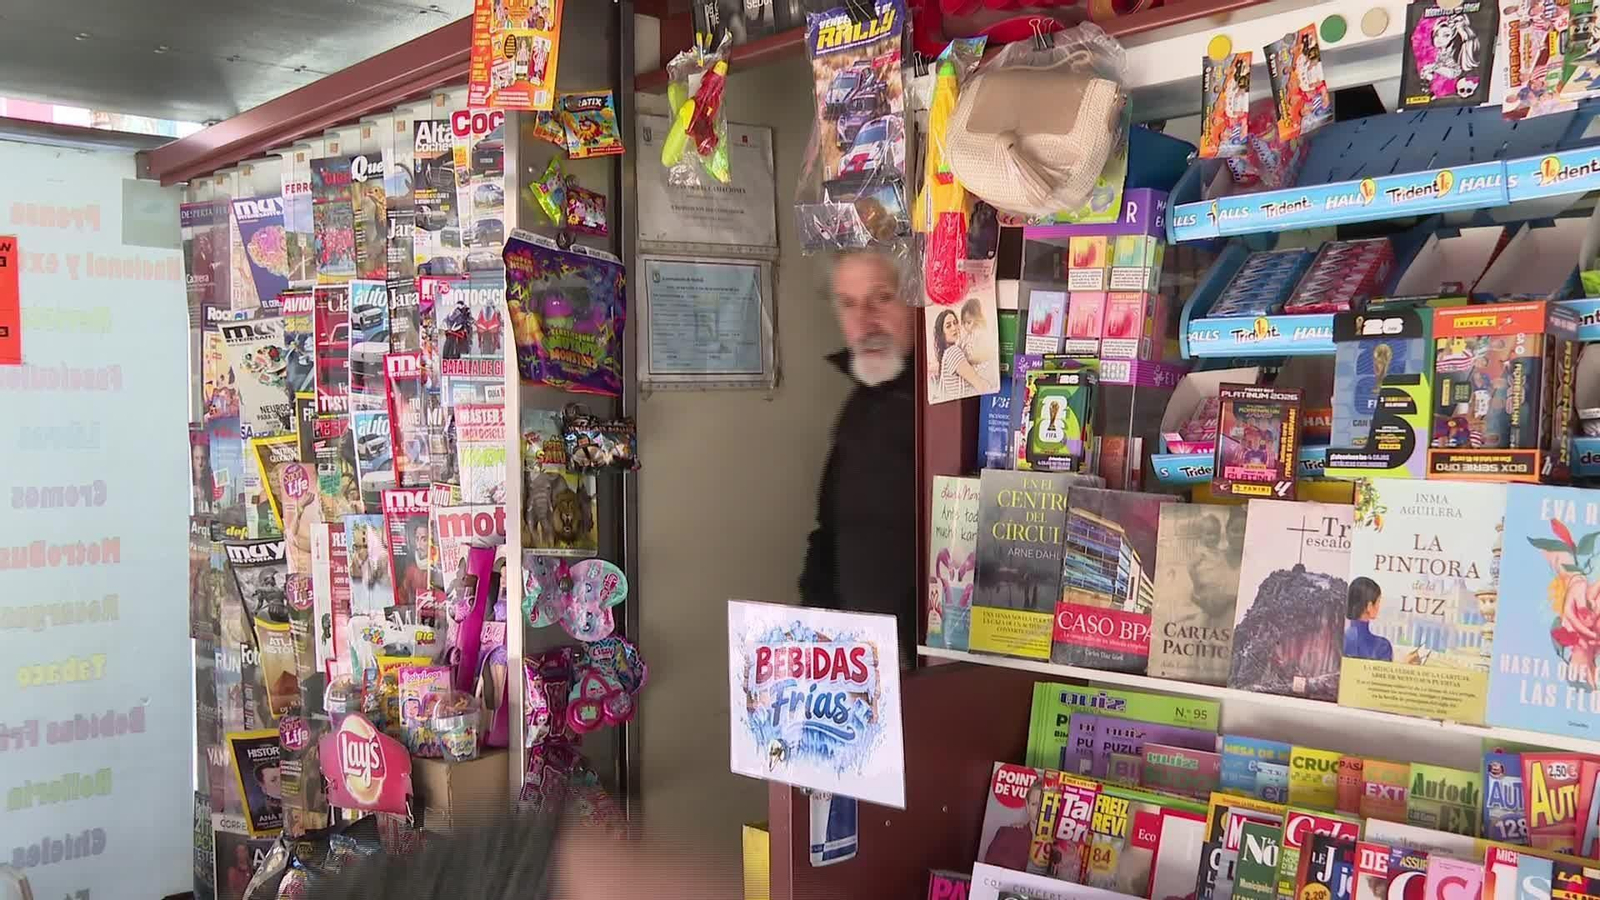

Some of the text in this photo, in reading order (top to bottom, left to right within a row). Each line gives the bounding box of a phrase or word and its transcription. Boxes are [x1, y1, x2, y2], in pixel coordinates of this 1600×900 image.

[816, 9, 897, 51] RALLY
[1261, 198, 1311, 220] Trident
[1386, 180, 1440, 204] Trident
[1126, 201, 1138, 224] R
[442, 360, 479, 374] BATALLA
[1221, 390, 1269, 400] PLATINUM
[1415, 493, 1448, 504] INMA
[1399, 506, 1463, 519] AGUILERA
[1540, 499, 1577, 525] EVA
[1305, 534, 1351, 549] escalo
[1413, 533, 1443, 552] LA
[1007, 547, 1034, 559] ARNE
[1373, 554, 1481, 580] PINTORA
[1399, 595, 1447, 617] LUZ
[1057, 611, 1114, 637] CASO
[755, 646, 869, 685] BEBIDAS
[1499, 652, 1550, 679] HASTA
[770, 683, 852, 727] Frías
[1519, 680, 1558, 708] LAS
[284, 726, 309, 749] Life
[994, 783, 1010, 794] DE
[996, 769, 1037, 788] POINT
[1137, 828, 1157, 842] Eco
[1092, 847, 1111, 865] 84
